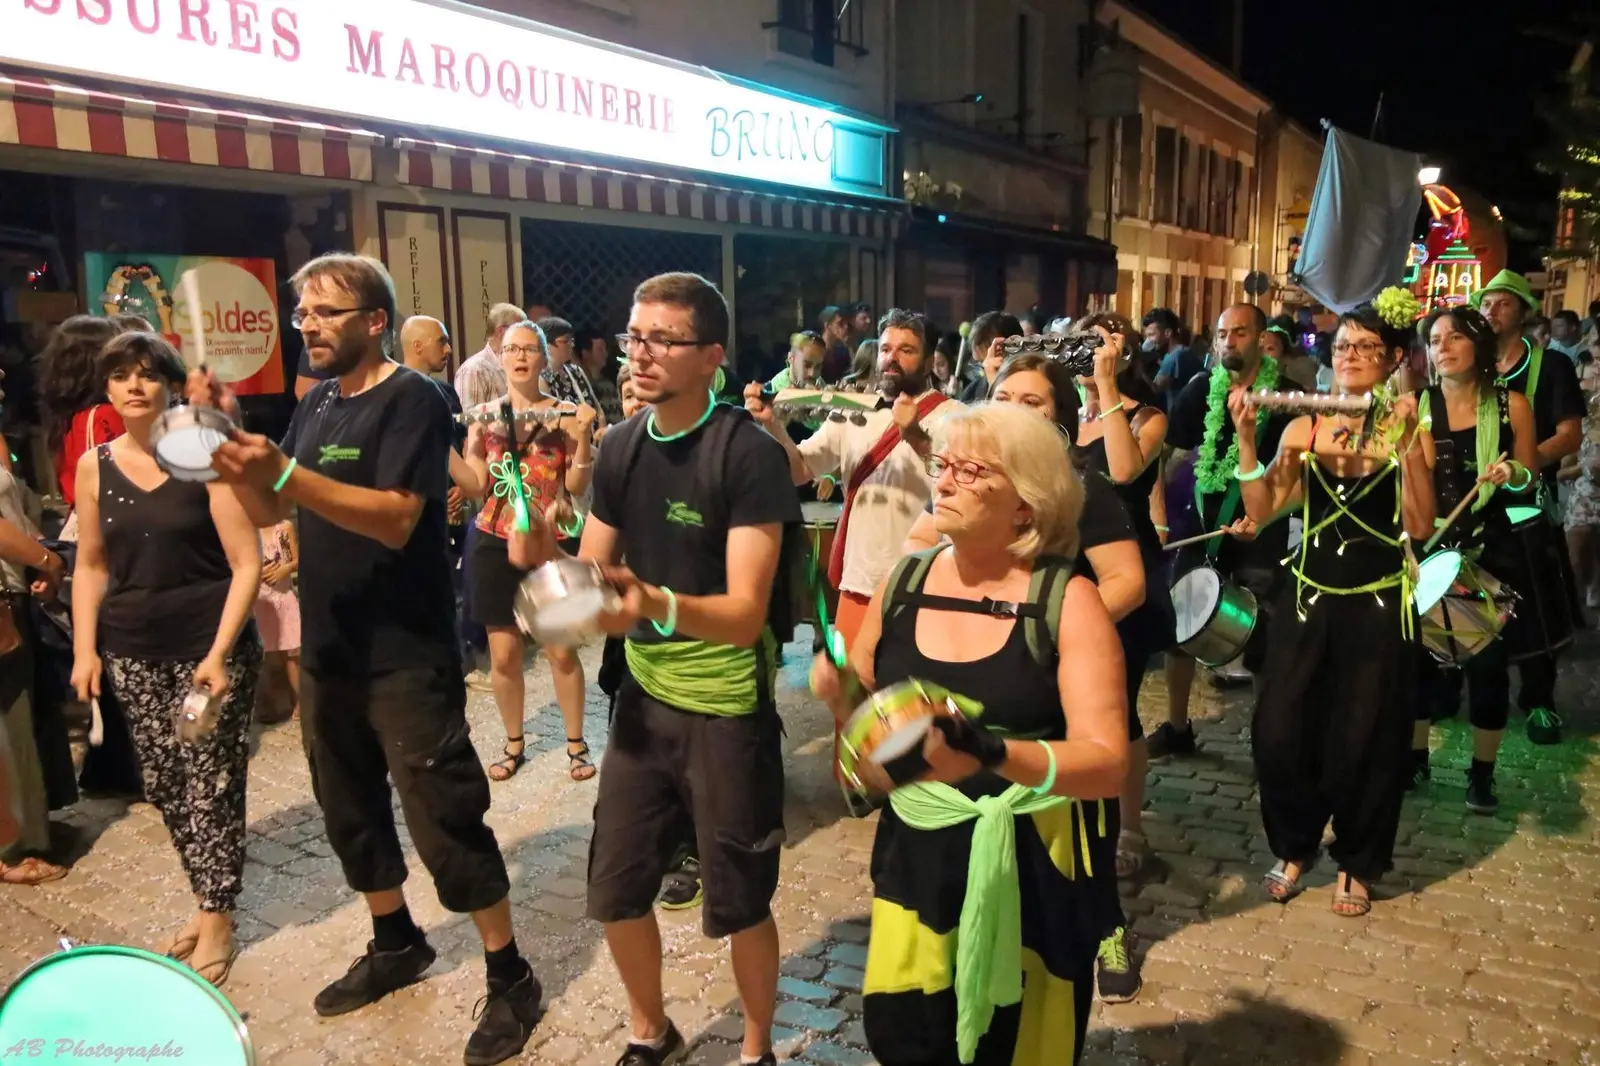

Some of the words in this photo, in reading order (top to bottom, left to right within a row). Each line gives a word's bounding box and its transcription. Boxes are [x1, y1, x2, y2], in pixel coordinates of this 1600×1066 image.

[343, 23, 676, 133] MAROQUINERIE
[706, 107, 834, 162] BRUNO
[173, 300, 273, 334] Soldes
